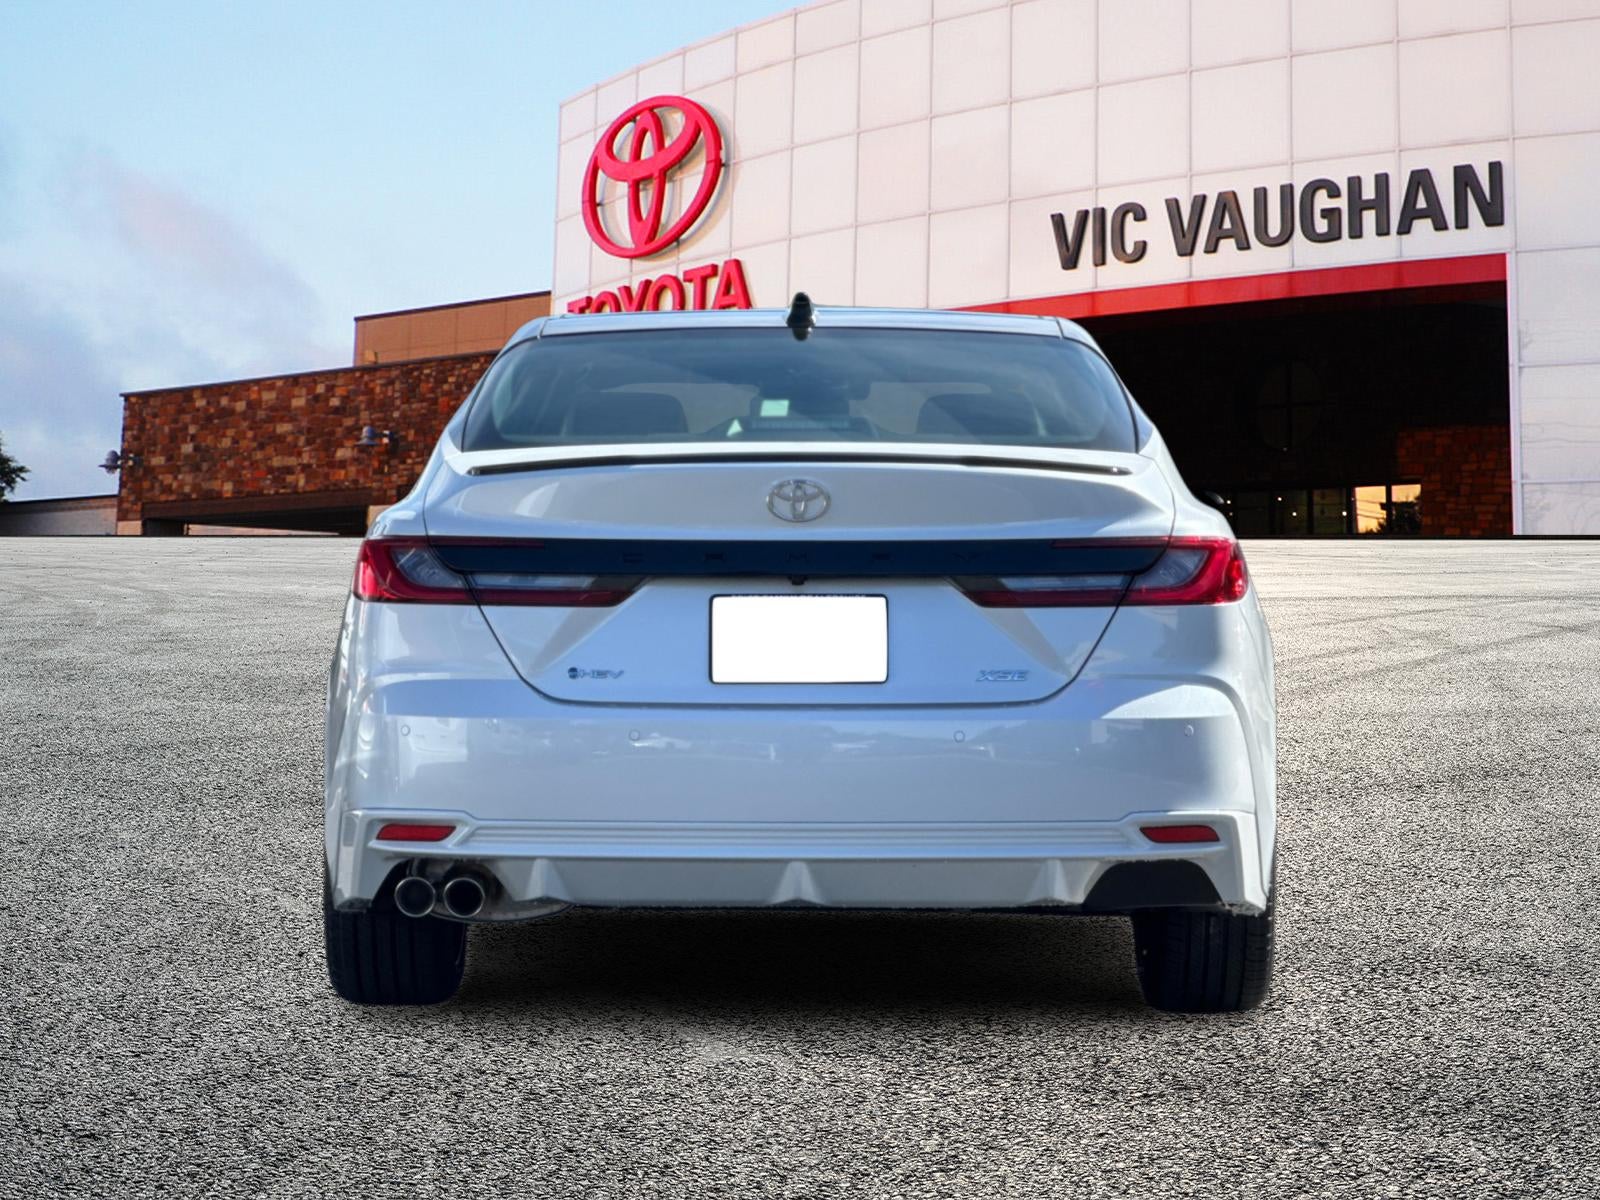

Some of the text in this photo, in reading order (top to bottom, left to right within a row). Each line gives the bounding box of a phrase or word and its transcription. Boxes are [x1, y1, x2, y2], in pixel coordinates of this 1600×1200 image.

[1051, 160, 1505, 270] VIC VAUGHAN
[976, 668, 1030, 682] XSE
